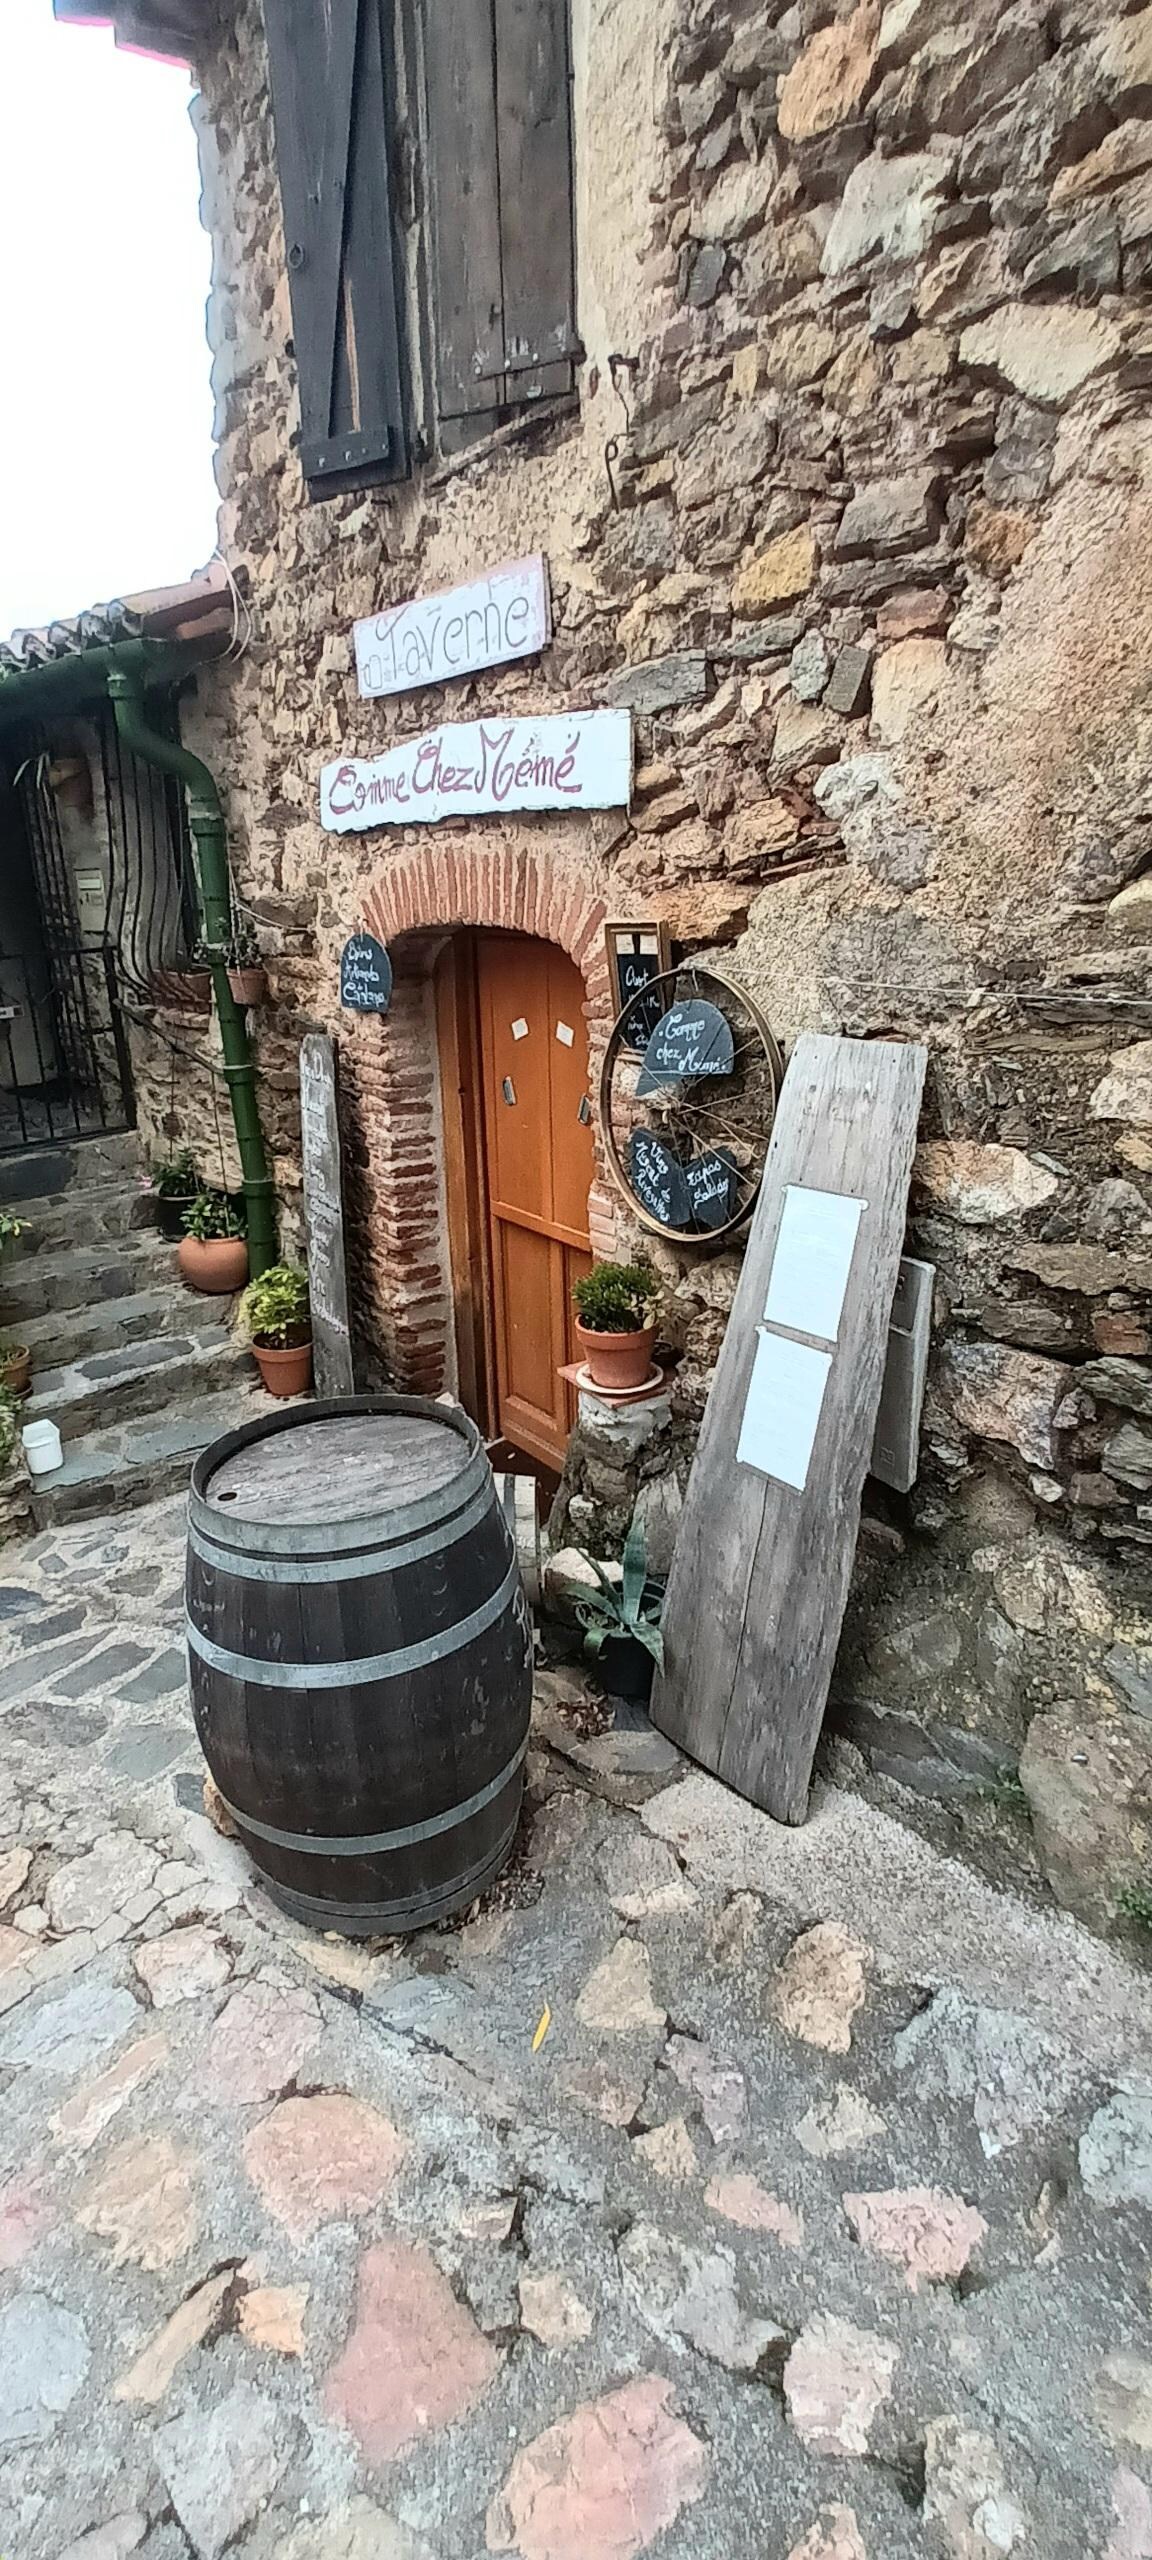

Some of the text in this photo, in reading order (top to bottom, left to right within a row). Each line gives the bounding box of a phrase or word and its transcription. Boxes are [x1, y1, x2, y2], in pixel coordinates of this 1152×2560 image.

[375, 596, 529, 680] Taverne
[329, 724, 582, 815] Comme Chez Mémé
[650, 1142, 669, 1175] Vins
